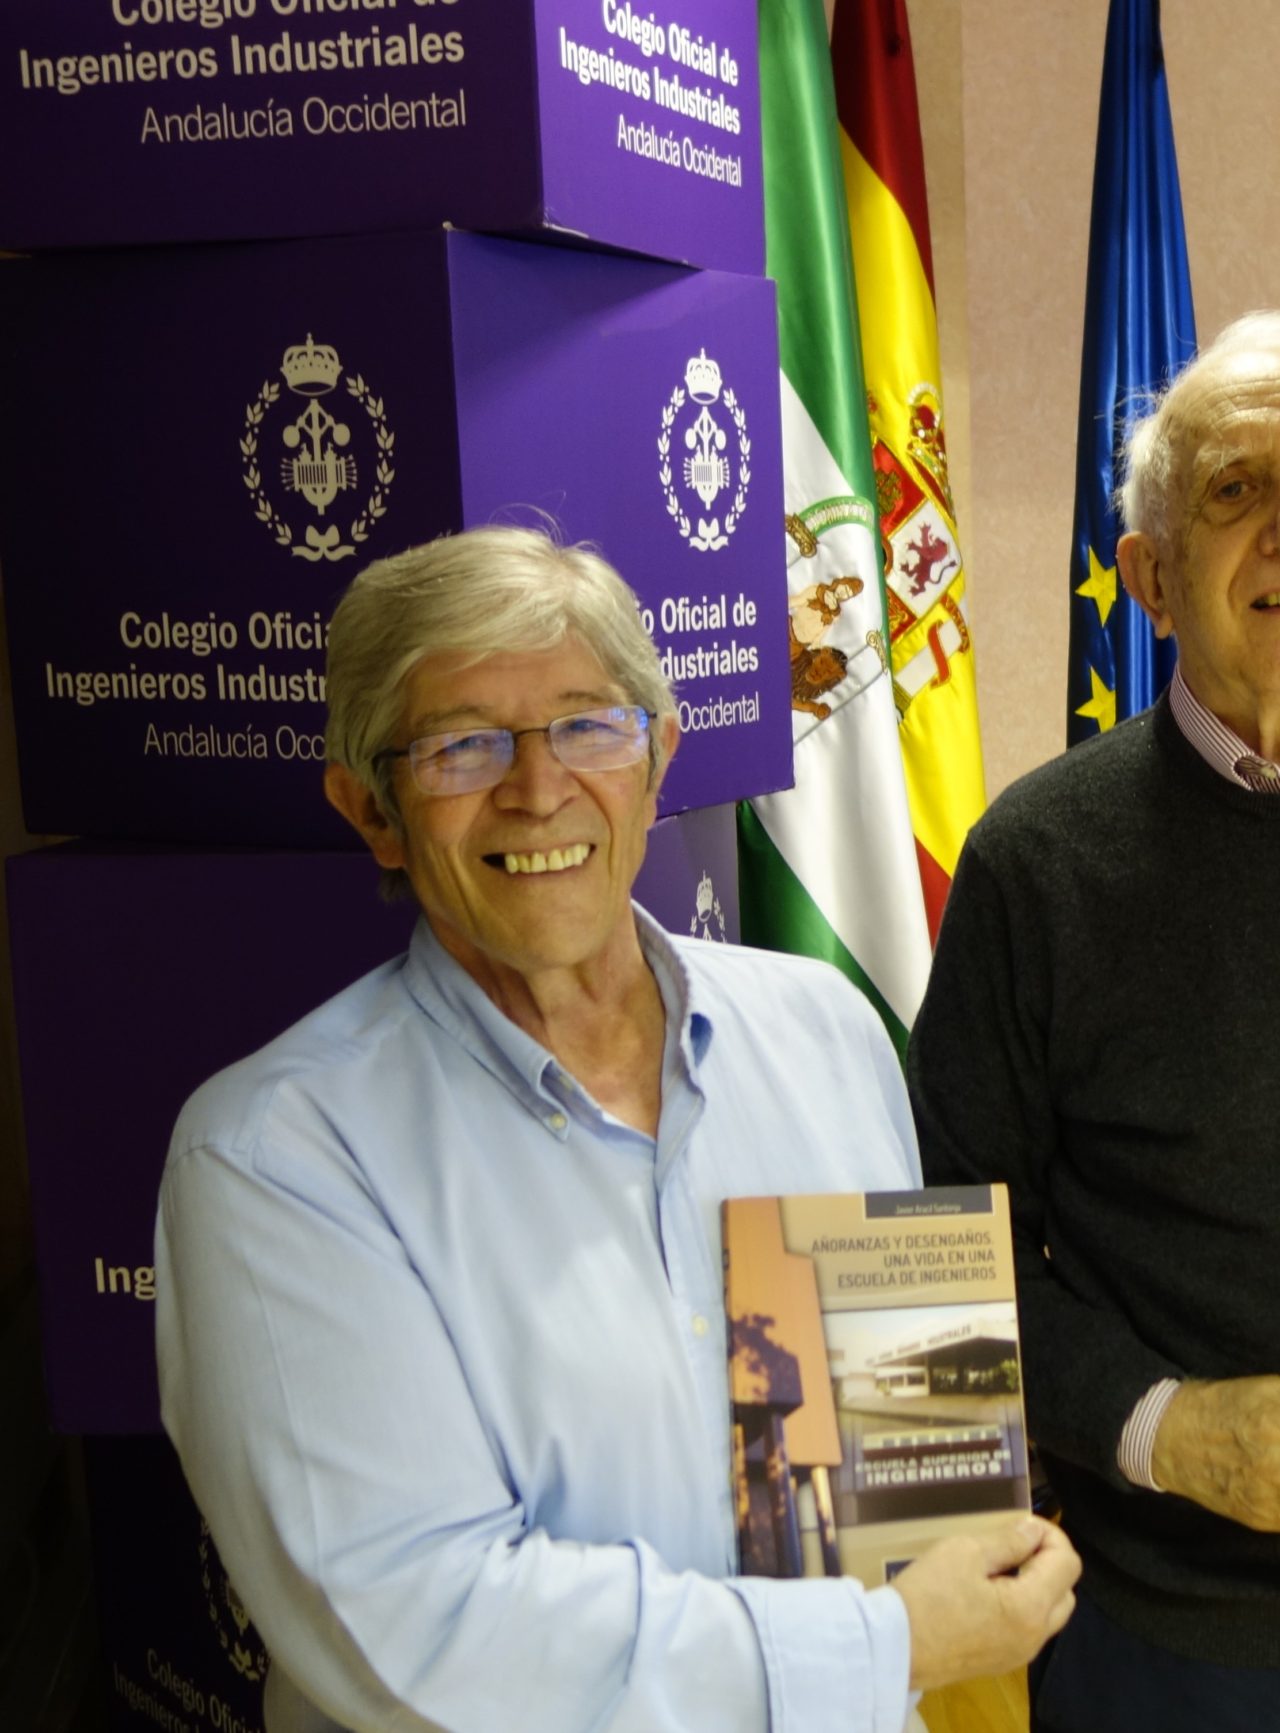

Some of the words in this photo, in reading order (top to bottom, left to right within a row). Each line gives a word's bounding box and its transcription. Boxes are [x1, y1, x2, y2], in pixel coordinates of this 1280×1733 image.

[19, 42, 218, 95] Ingenieros
[230, 23, 465, 76] Industriales
[603, 0, 666, 57] Colegio
[668, 23, 717, 78] Oficial
[720, 48, 738, 87] de
[559, 27, 651, 100] Ingenieros
[654, 66, 741, 135] Industriales
[140, 98, 294, 144] Andalucía
[302, 89, 467, 135] Occidental
[617, 113, 681, 168] Andalucía
[682, 137, 742, 187] Occidental
[120, 612, 238, 657] Colegio
[248, 612, 329, 649] Ofici
[660, 594, 727, 634] Oficial
[733, 593, 757, 628] de
[660, 640, 759, 681] dustriales
[46, 663, 207, 706] Ingenieros
[217, 664, 327, 702] Industr
[678, 691, 760, 733] Occidental
[144, 723, 268, 758] Andalucía
[811, 1235, 890, 1253] AÑORANZAS
[895, 1237, 903, 1249] Y
[884, 1253, 910, 1268] UNA
[914, 1252, 944, 1266] VIDA
[948, 1251, 964, 1264] EN
[969, 1250, 995, 1263] UNA
[837, 1273, 896, 1288] ESCUELA
[900, 1271, 917, 1285] DE
[920, 1267, 996, 1284] INGENIEROS
[866, 1461, 1001, 1486] INGENIEROS
[146, 1647, 205, 1716] Colegio
